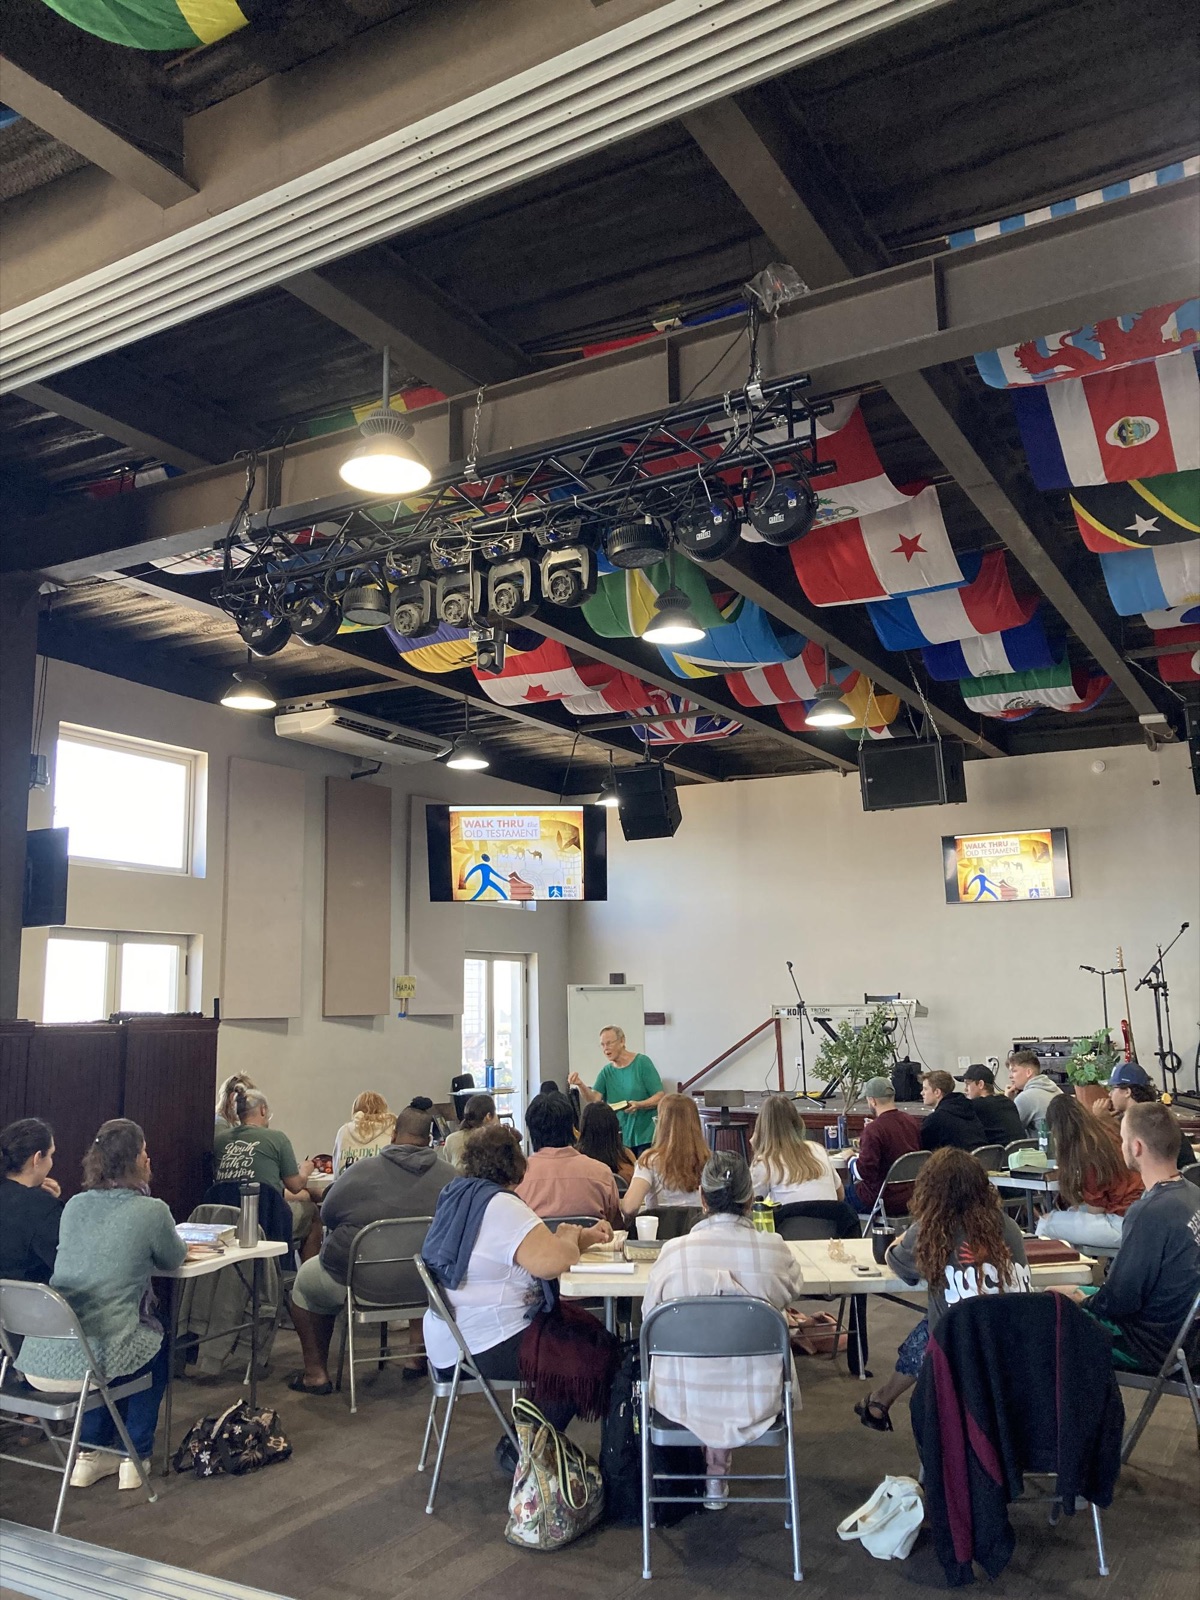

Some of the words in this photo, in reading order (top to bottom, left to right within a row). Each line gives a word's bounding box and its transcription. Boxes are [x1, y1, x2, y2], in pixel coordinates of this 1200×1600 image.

[463, 820, 494, 828] WALK
[498, 820, 525, 828] THRU
[464, 829, 483, 838] OLD
[486, 829, 538, 838] TESTAMENT
[981, 848, 1018, 856] TESTAMENT
[225, 1140, 260, 1156] Youth
[340, 1146, 358, 1160] Take
[359, 1147, 374, 1158] me
[241, 1157, 254, 1168] a
